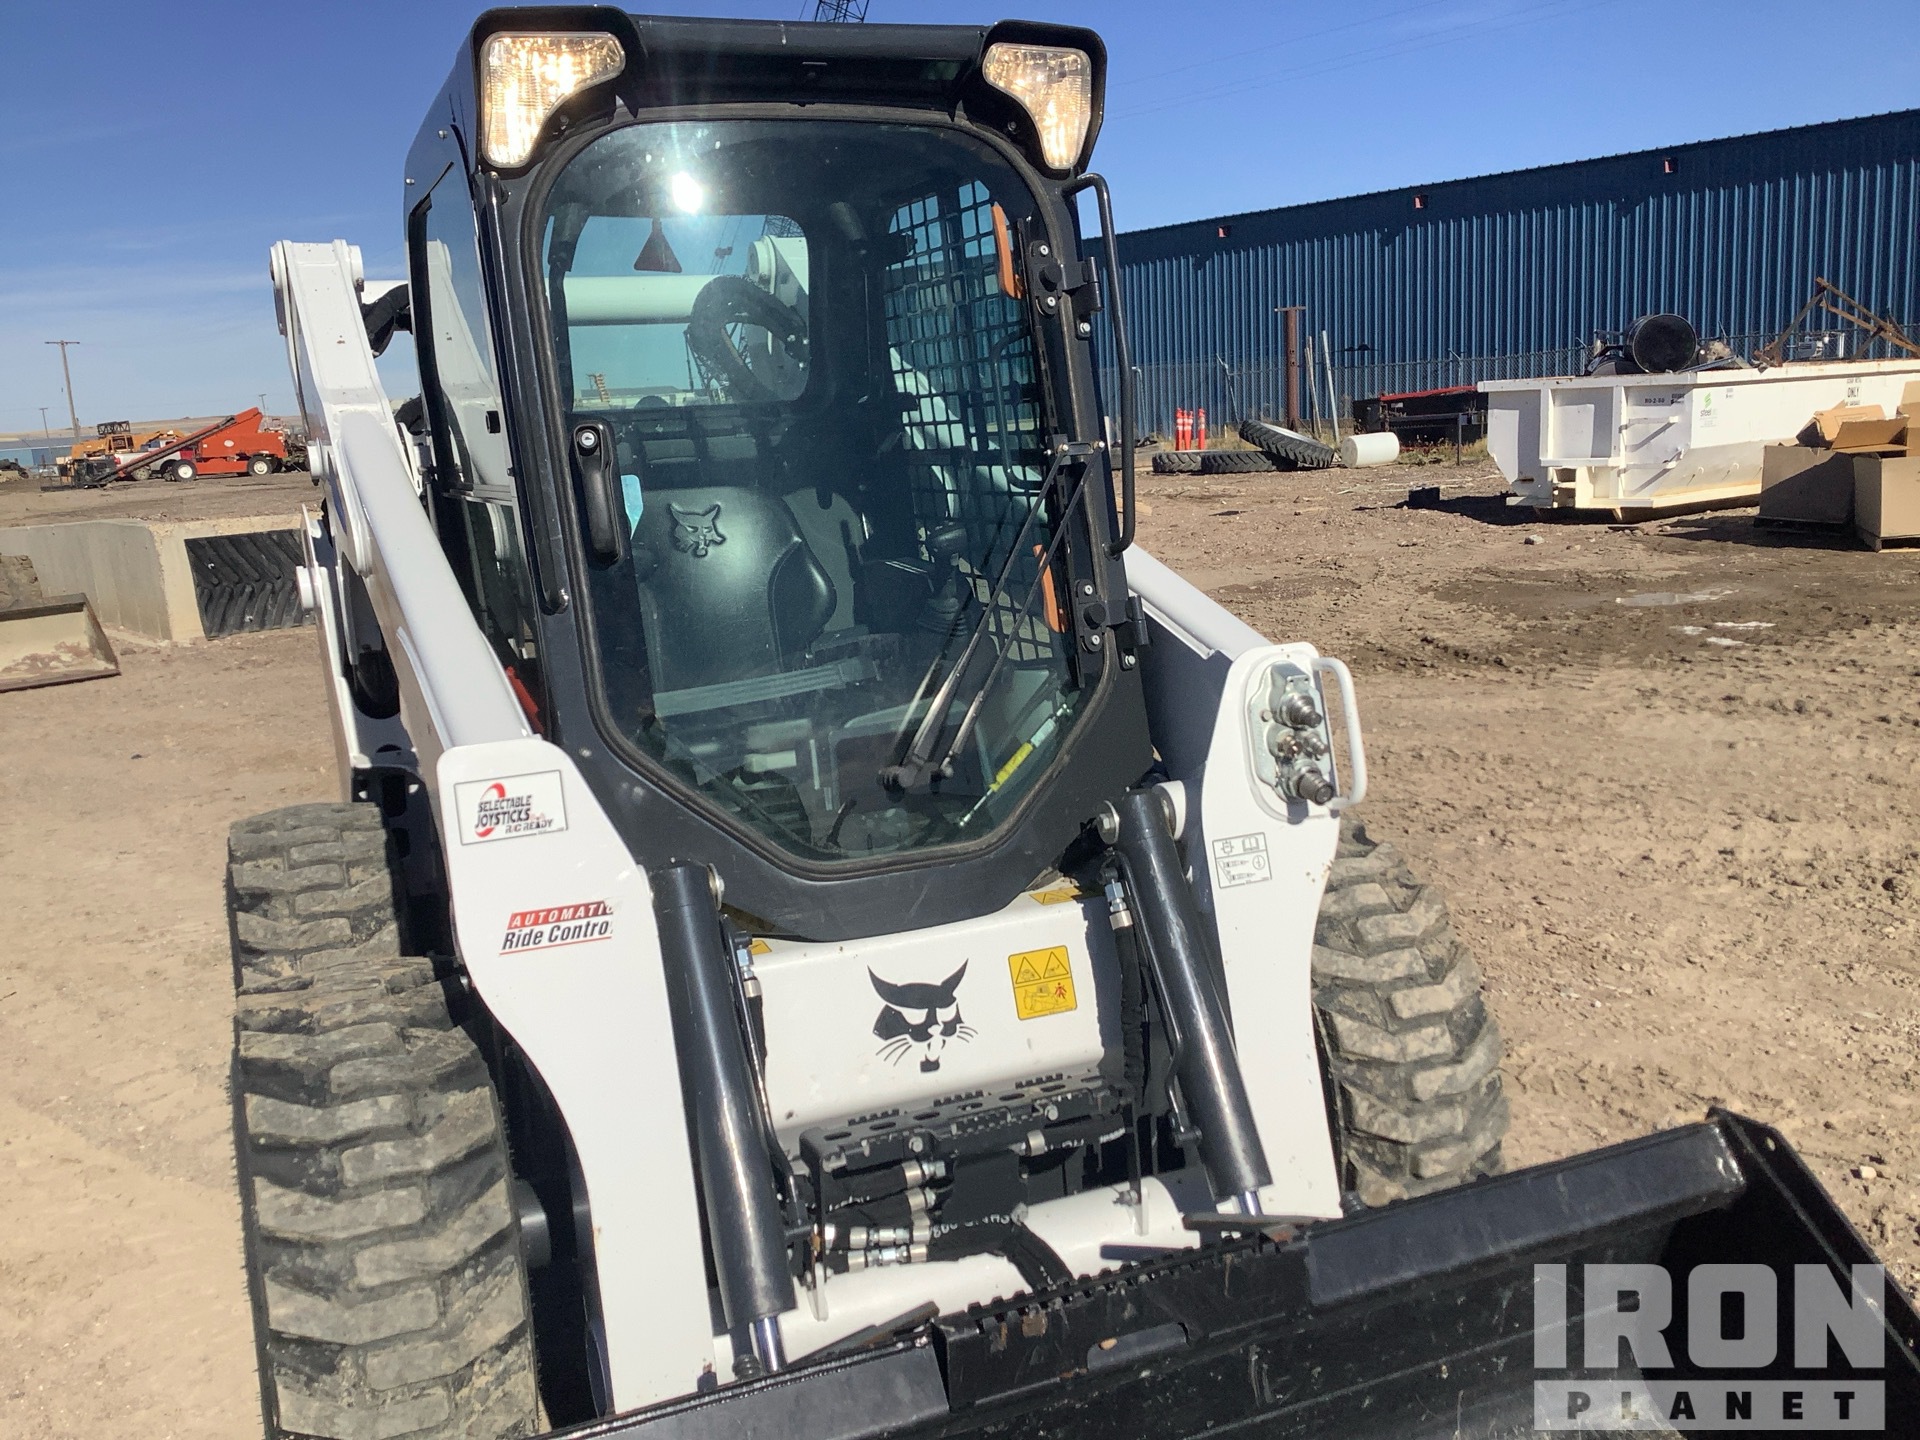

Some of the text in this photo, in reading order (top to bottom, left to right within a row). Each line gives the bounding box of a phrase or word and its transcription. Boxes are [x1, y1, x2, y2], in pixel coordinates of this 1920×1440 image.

[478, 795, 532, 813] SELECTABLE
[475, 808, 531, 829] JOYSTICKS
[523, 819, 553, 831] READY
[502, 920, 613, 950] Ride Contro
